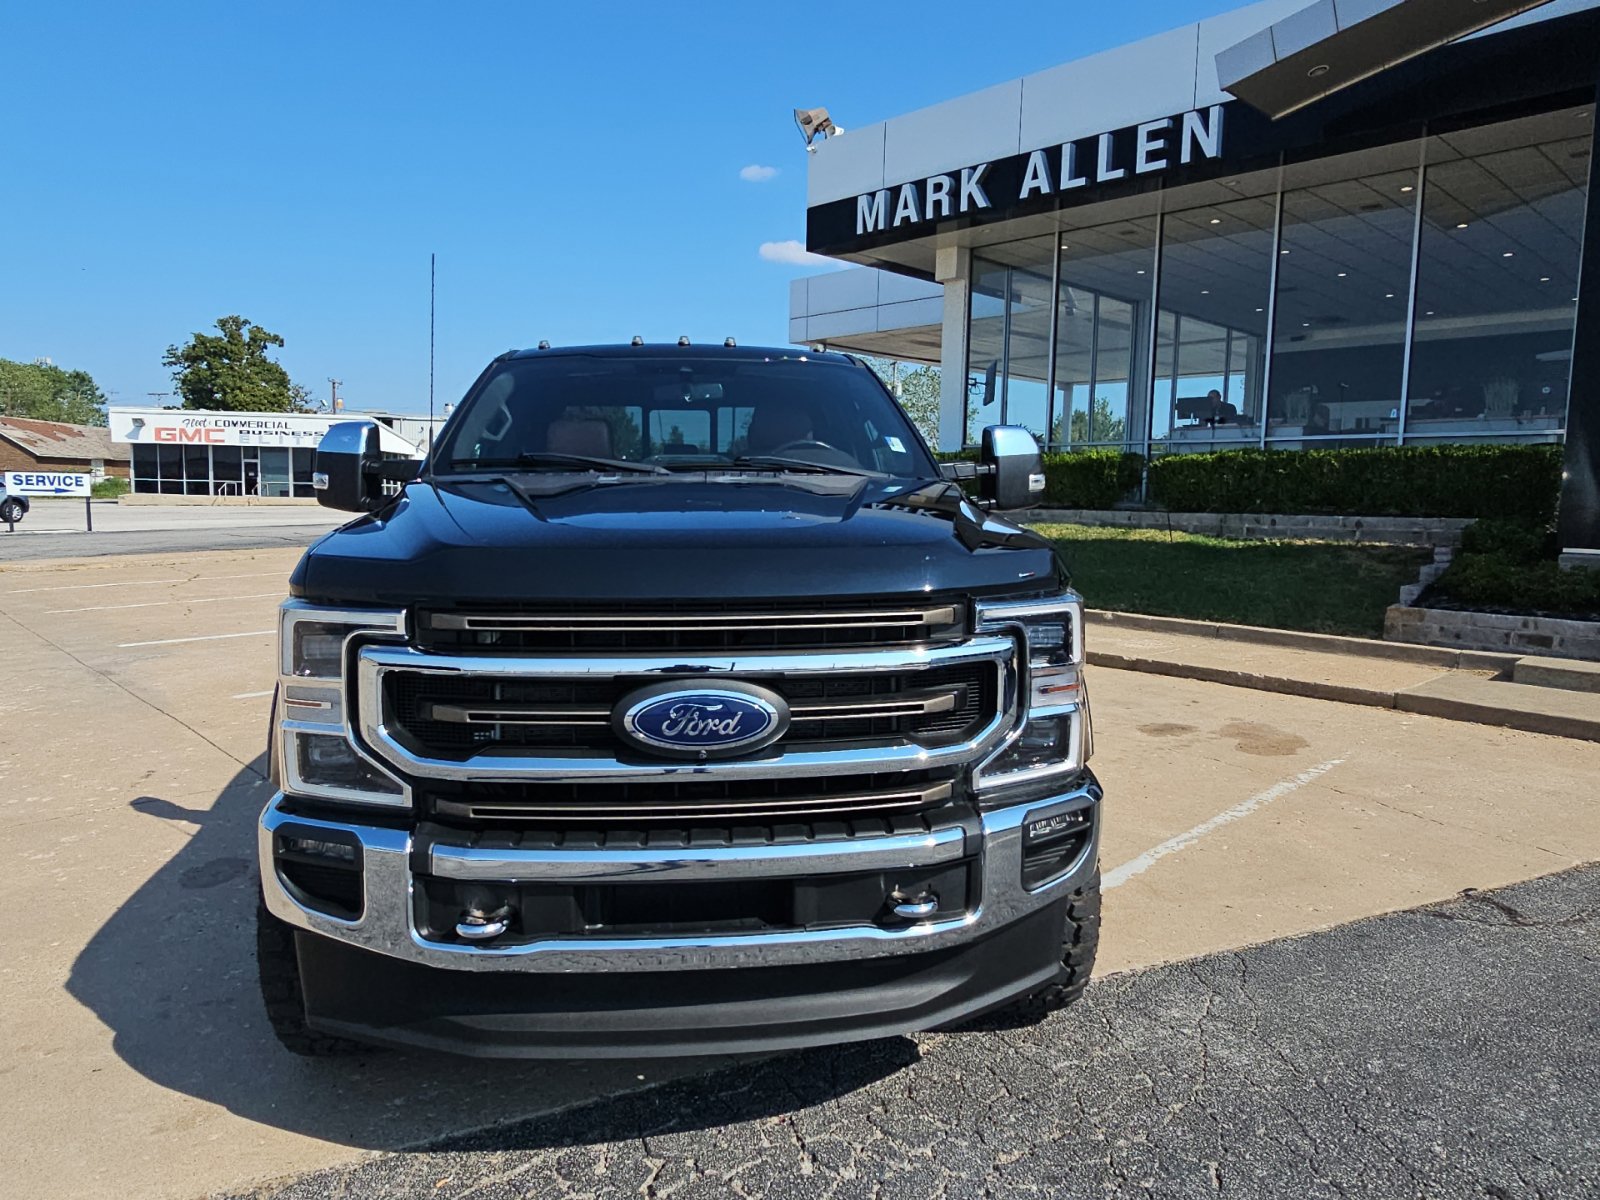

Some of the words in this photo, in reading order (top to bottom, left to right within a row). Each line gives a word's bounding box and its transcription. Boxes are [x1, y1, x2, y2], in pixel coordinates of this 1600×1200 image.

[856, 163, 992, 235] MARK
[1019, 104, 1224, 200] ALLEN
[214, 419, 292, 429] COMMERCIAL
[154, 427, 226, 444] GMC
[239, 429, 325, 437] BUSINESS
[12, 474, 84, 487] SERVICE
[661, 703, 743, 736] Ford
